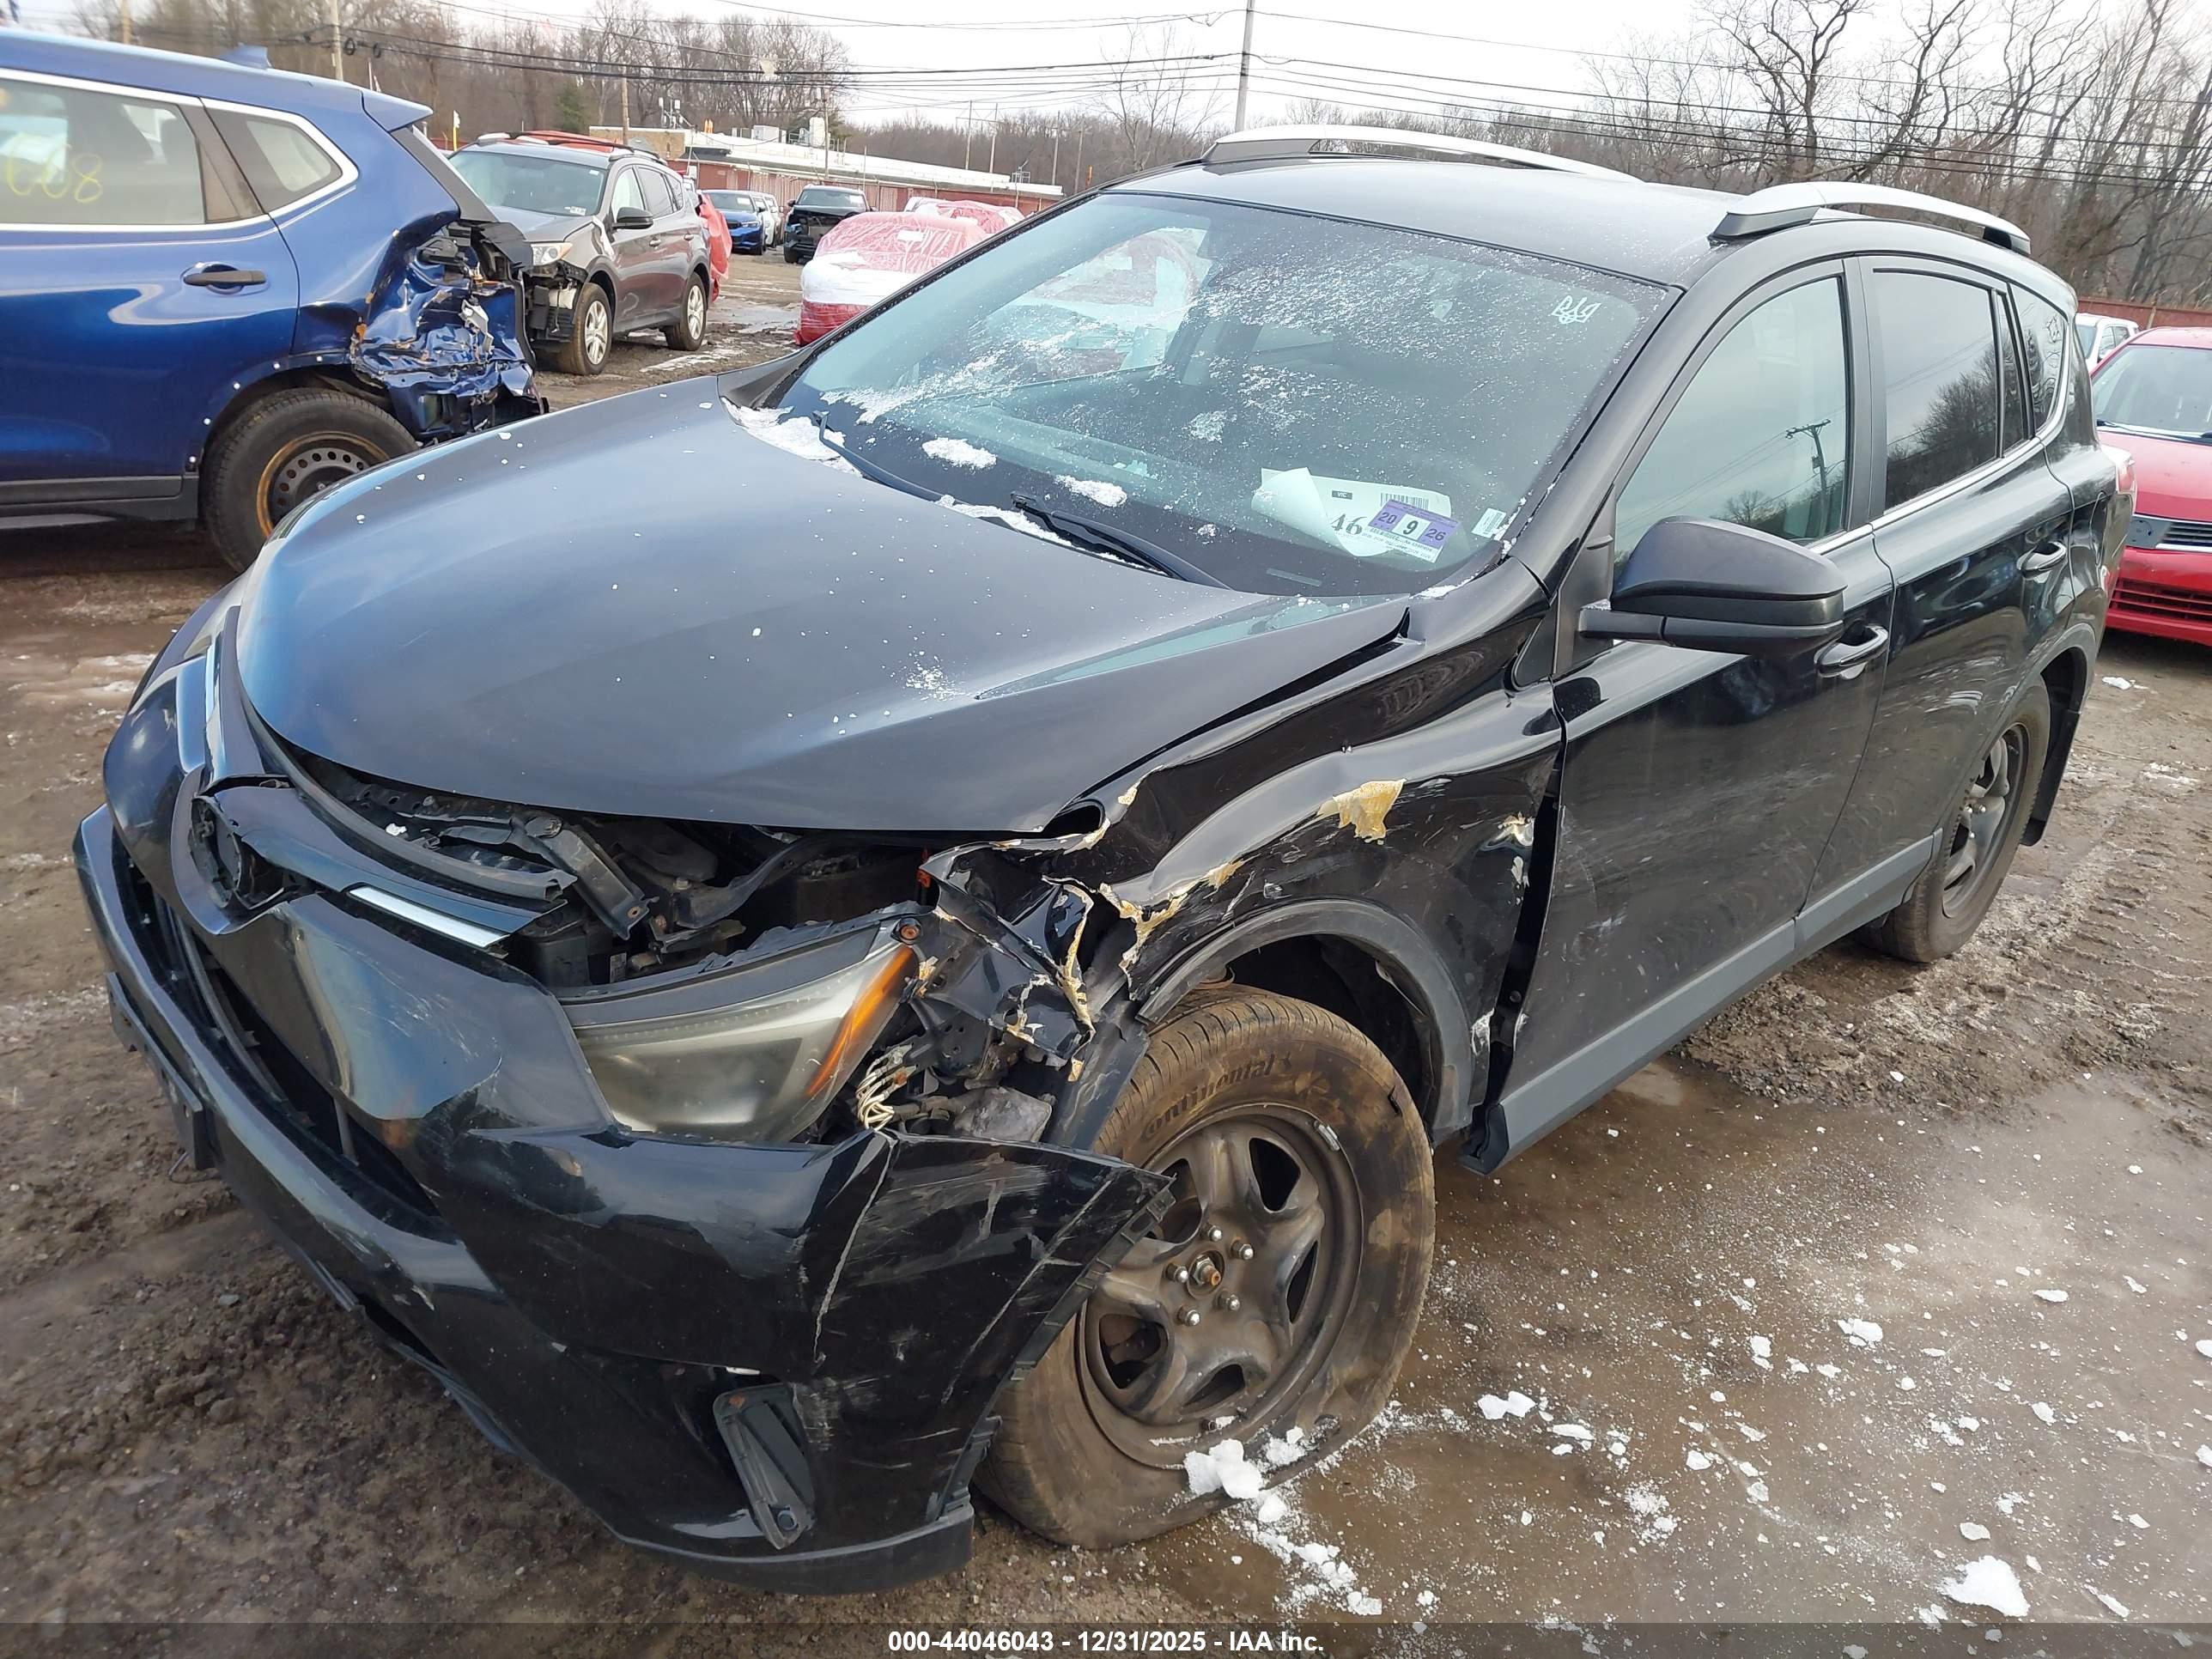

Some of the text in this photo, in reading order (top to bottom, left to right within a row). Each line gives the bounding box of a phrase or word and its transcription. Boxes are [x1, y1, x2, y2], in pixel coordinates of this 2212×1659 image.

[1378, 512, 1398, 525] 20
[1402, 520, 1419, 535] 9
[1425, 528, 1446, 541] 26
